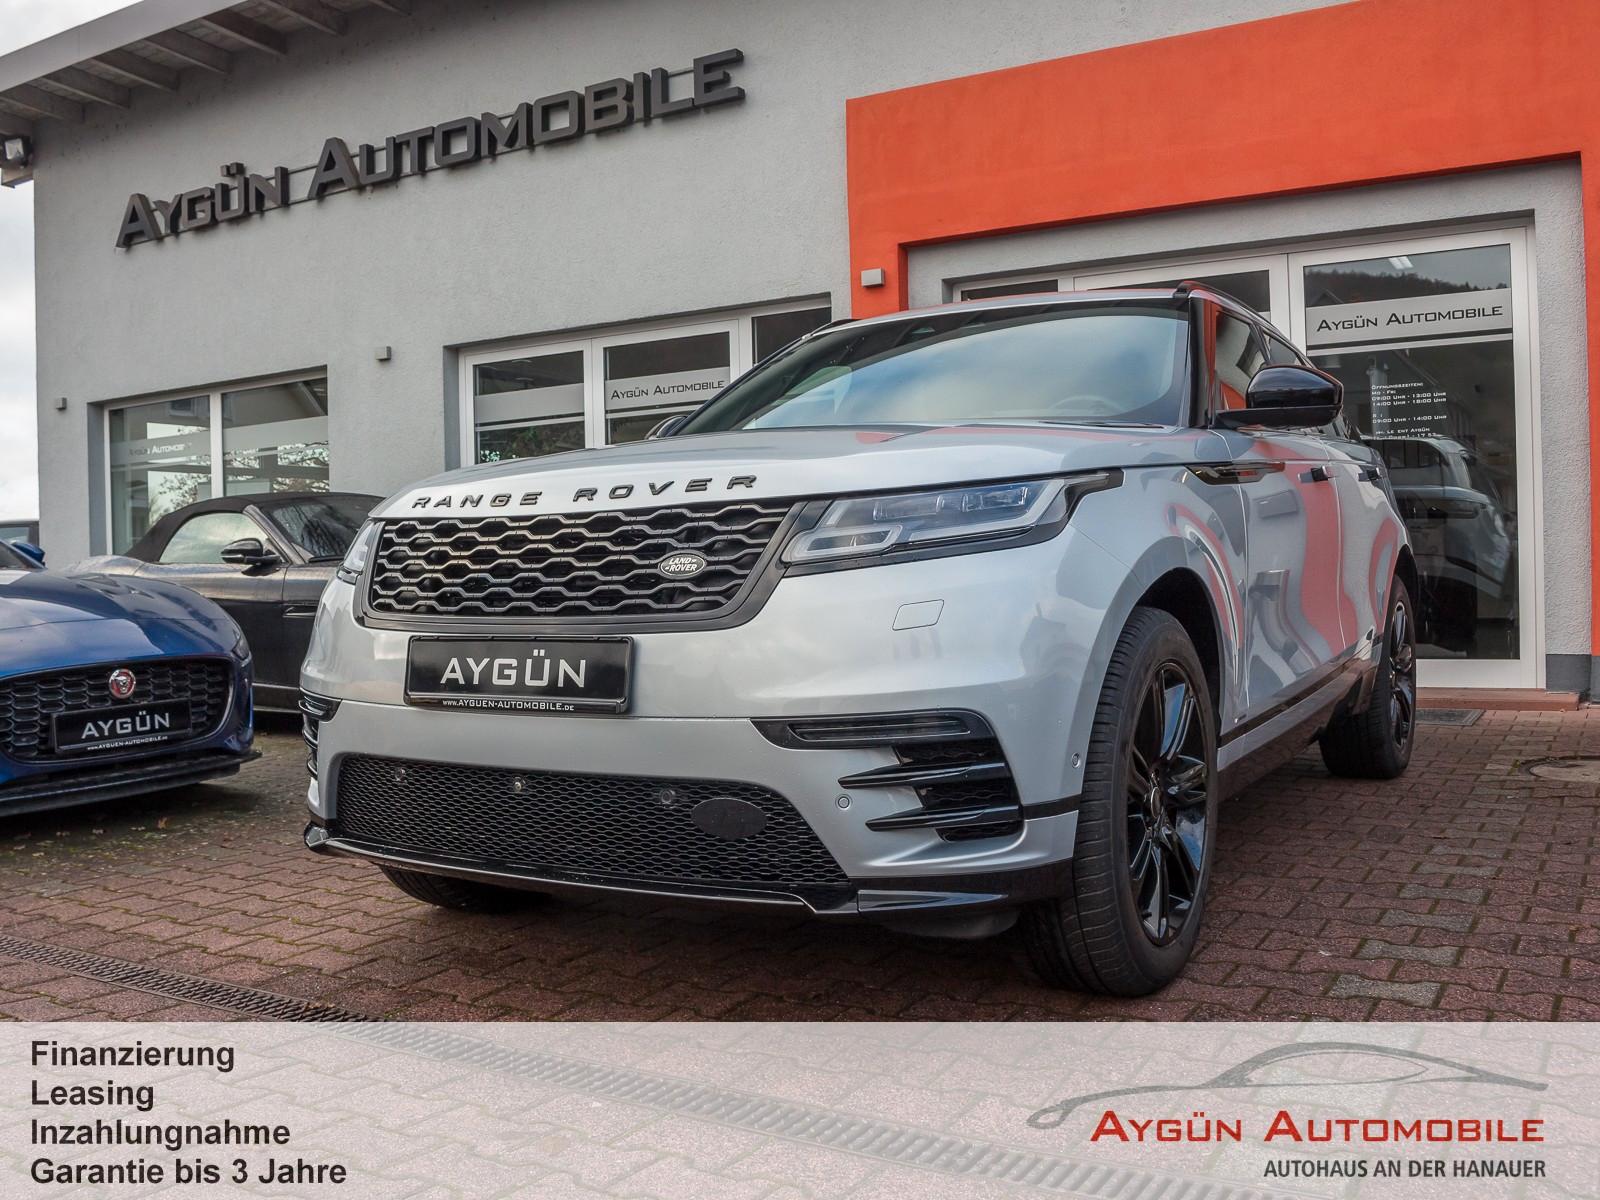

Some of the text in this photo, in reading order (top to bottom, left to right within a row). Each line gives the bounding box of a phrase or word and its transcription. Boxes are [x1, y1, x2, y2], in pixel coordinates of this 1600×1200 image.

[115, 48, 745, 249] AYGÜN AUTOMOBILE
[1316, 305, 1503, 332] AYGÜN AUTOMOBILE
[610, 380, 725, 400] AYGÜN AUTOMOBILE
[411, 474, 757, 509] RANGE ROVER
[669, 557, 692, 565] LAND
[669, 563, 698, 572] ROVER
[440, 649, 587, 689] AYGÜN
[81, 710, 170, 739] AYGÜN
